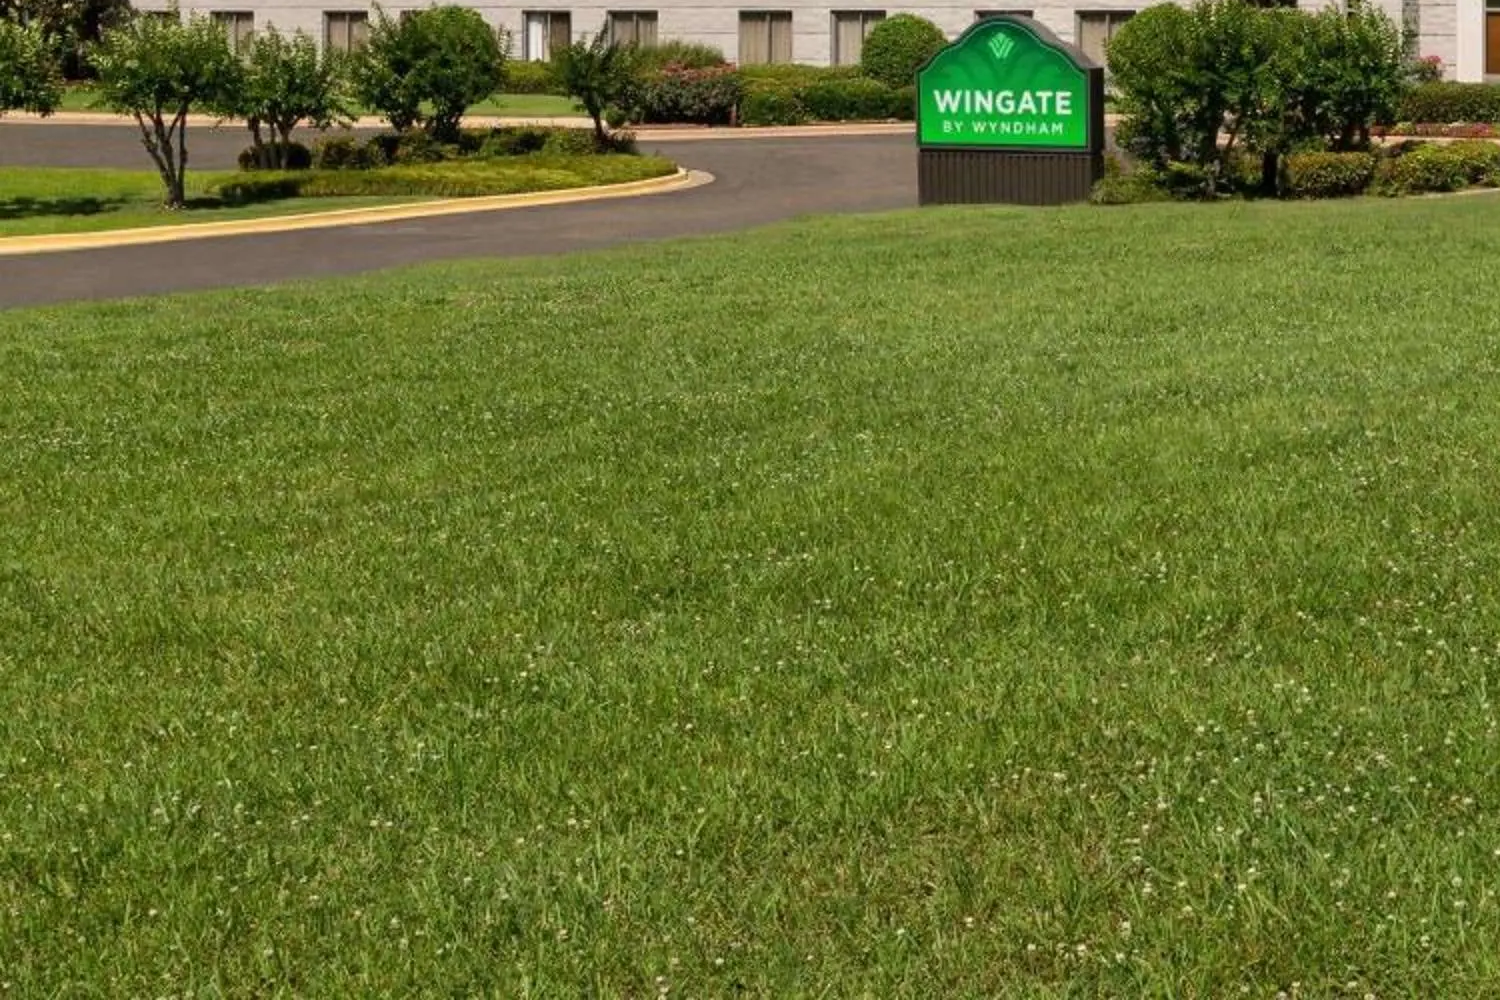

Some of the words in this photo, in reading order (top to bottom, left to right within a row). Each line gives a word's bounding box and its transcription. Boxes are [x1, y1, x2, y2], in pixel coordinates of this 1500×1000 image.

[933, 89, 1073, 115] WINGATE
[943, 121, 964, 133] BY
[971, 121, 1064, 135] WYNDHAM
